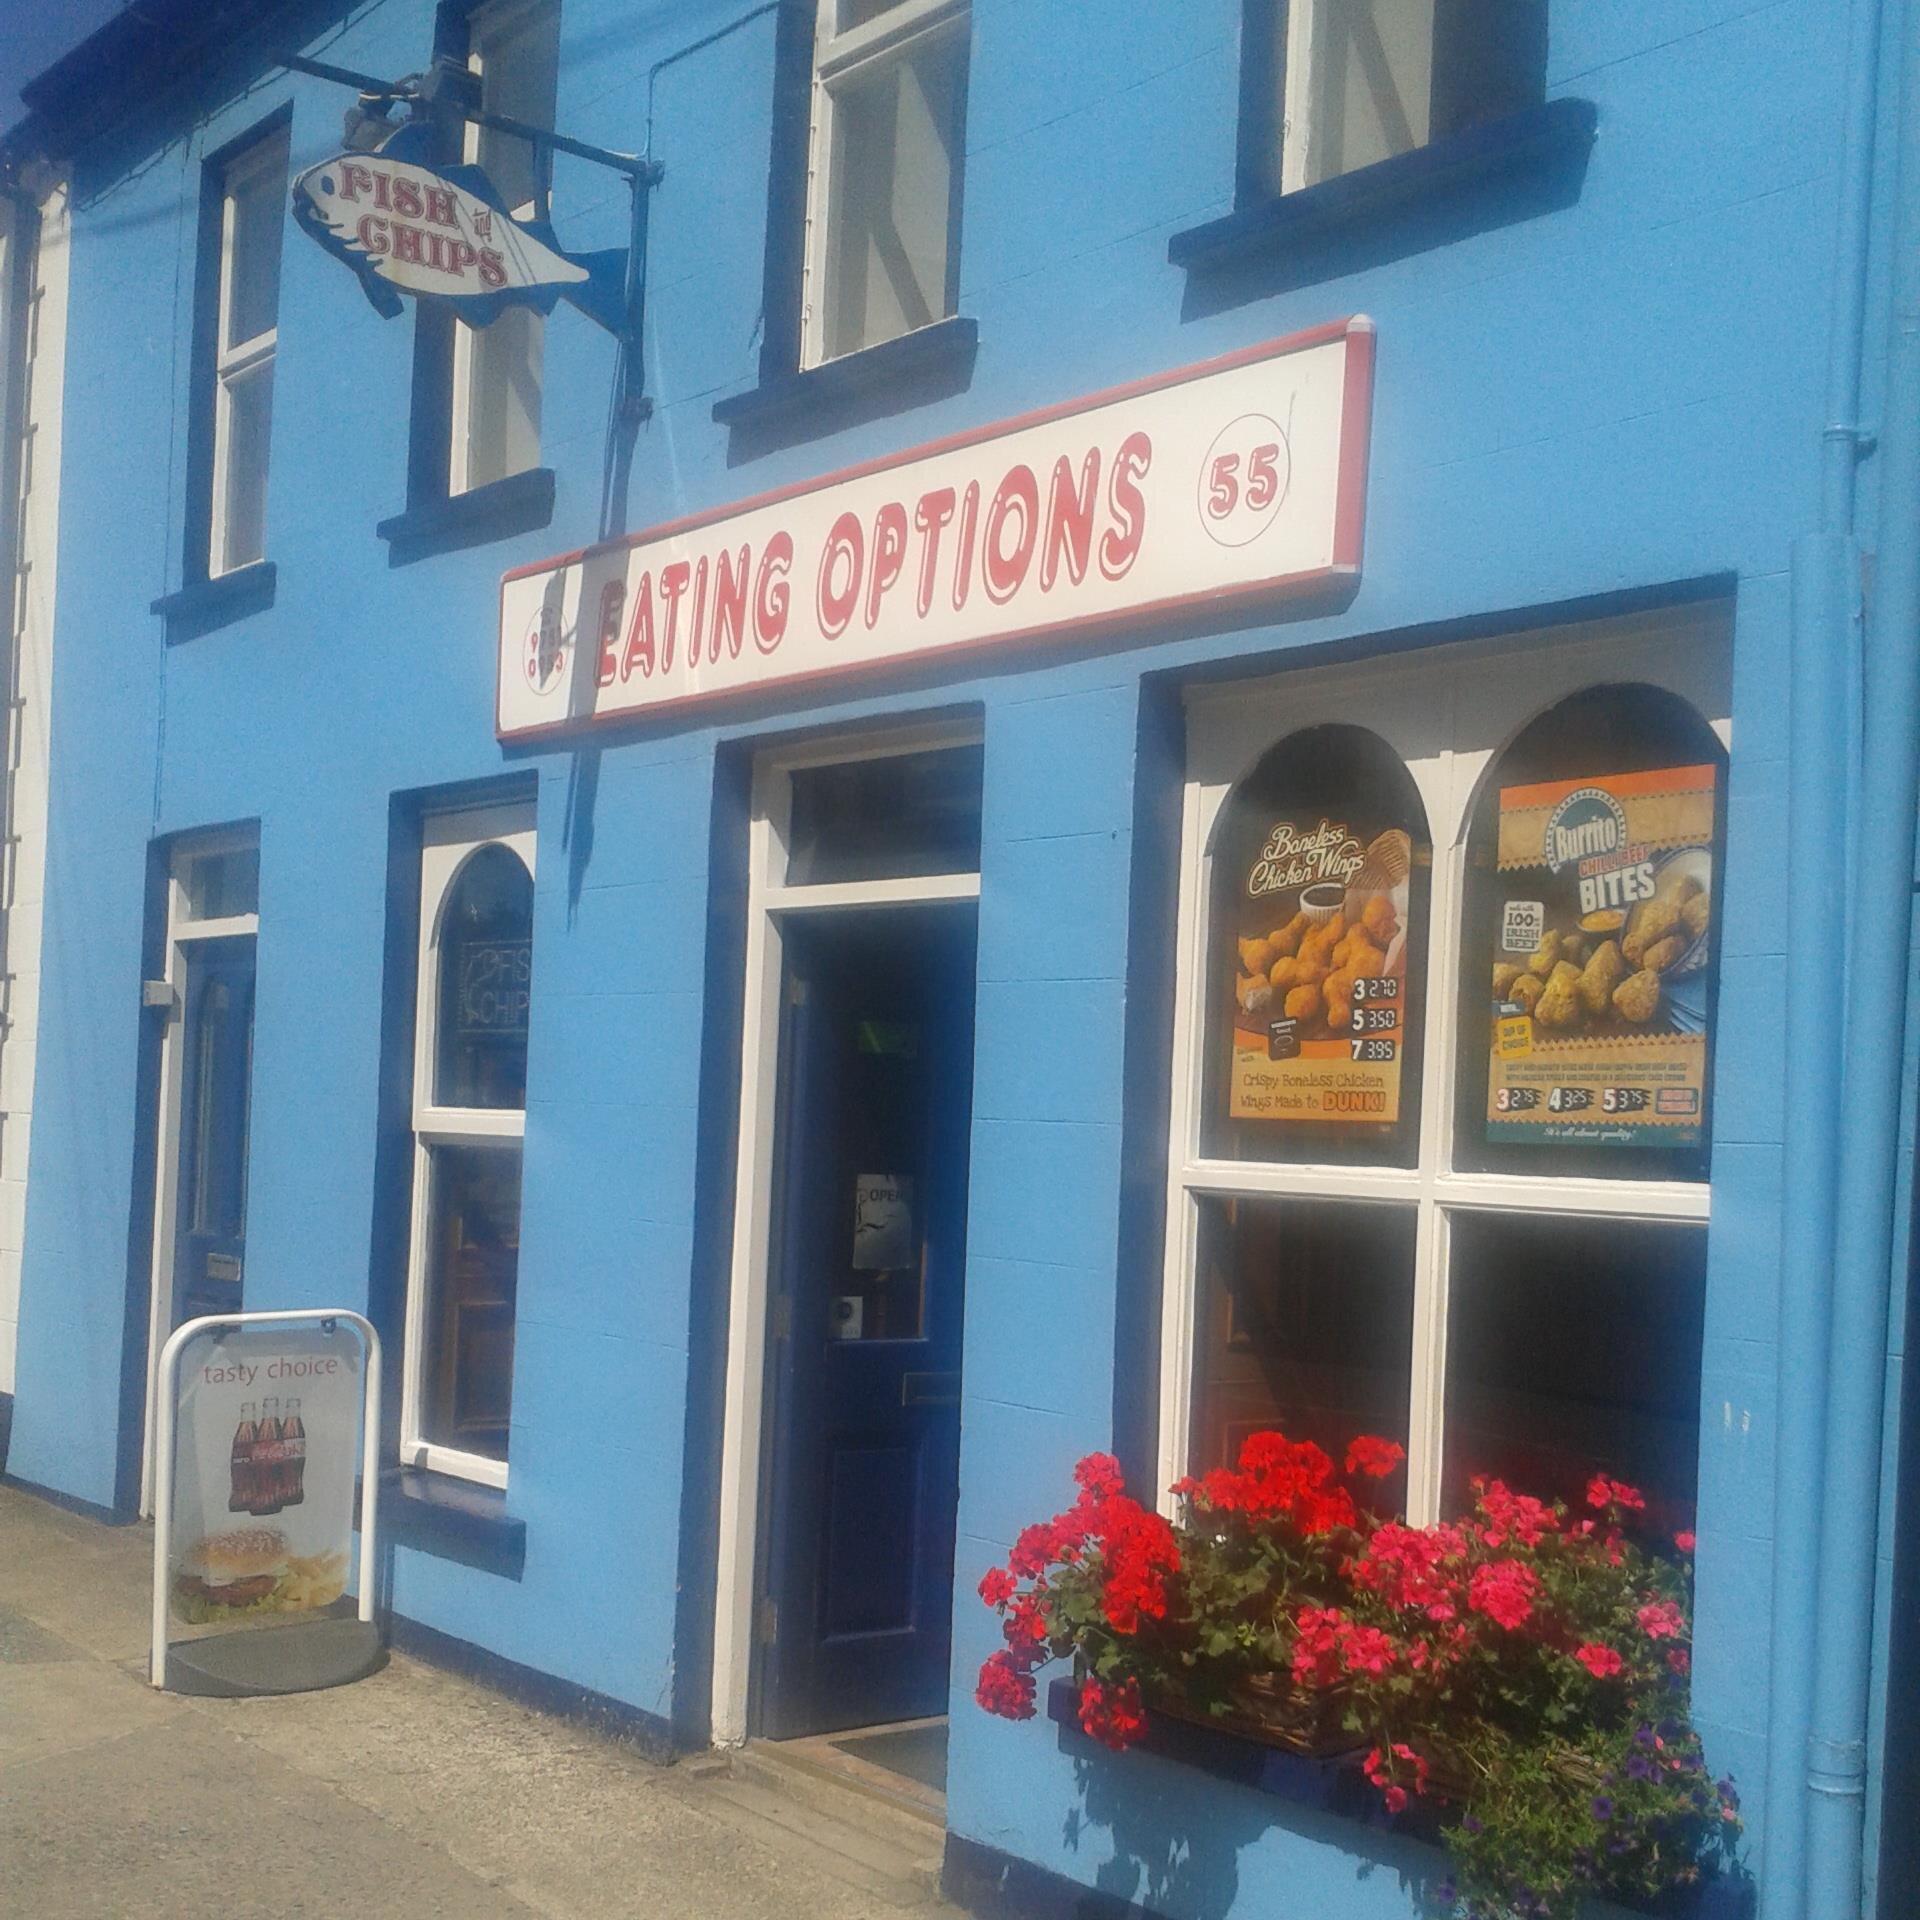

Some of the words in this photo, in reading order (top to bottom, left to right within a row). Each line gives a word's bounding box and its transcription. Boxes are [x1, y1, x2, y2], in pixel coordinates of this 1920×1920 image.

[338, 161, 459, 230] FISH
[356, 212, 509, 288] CHIPS
[1207, 443, 1279, 520] 55
[593, 530, 794, 688] EATING
[816, 431, 1152, 641] OPTIONS
[1264, 822, 1344, 861] Boneless
[1556, 816, 1617, 862] Burrito
[1249, 860, 1312, 895] Chicken
[1306, 840, 1364, 884] Wings
[1580, 862, 1656, 914] BITES
[1354, 978, 1366, 1000] 3
[1352, 1008, 1364, 1031] 5
[1352, 1039, 1363, 1060] 7
[1243, 1073, 1279, 1090] Crispy
[1283, 1073, 1333, 1087] Boneless
[1336, 1073, 1384, 1088] Chicken
[1322, 1090, 1386, 1112] DUNK!
[1496, 1088, 1509, 1110] 3
[1549, 1088, 1561, 1110] 4
[1602, 1088, 1616, 1111] 5
[204, 1363, 259, 1387] tasty
[267, 1357, 338, 1380] choice
